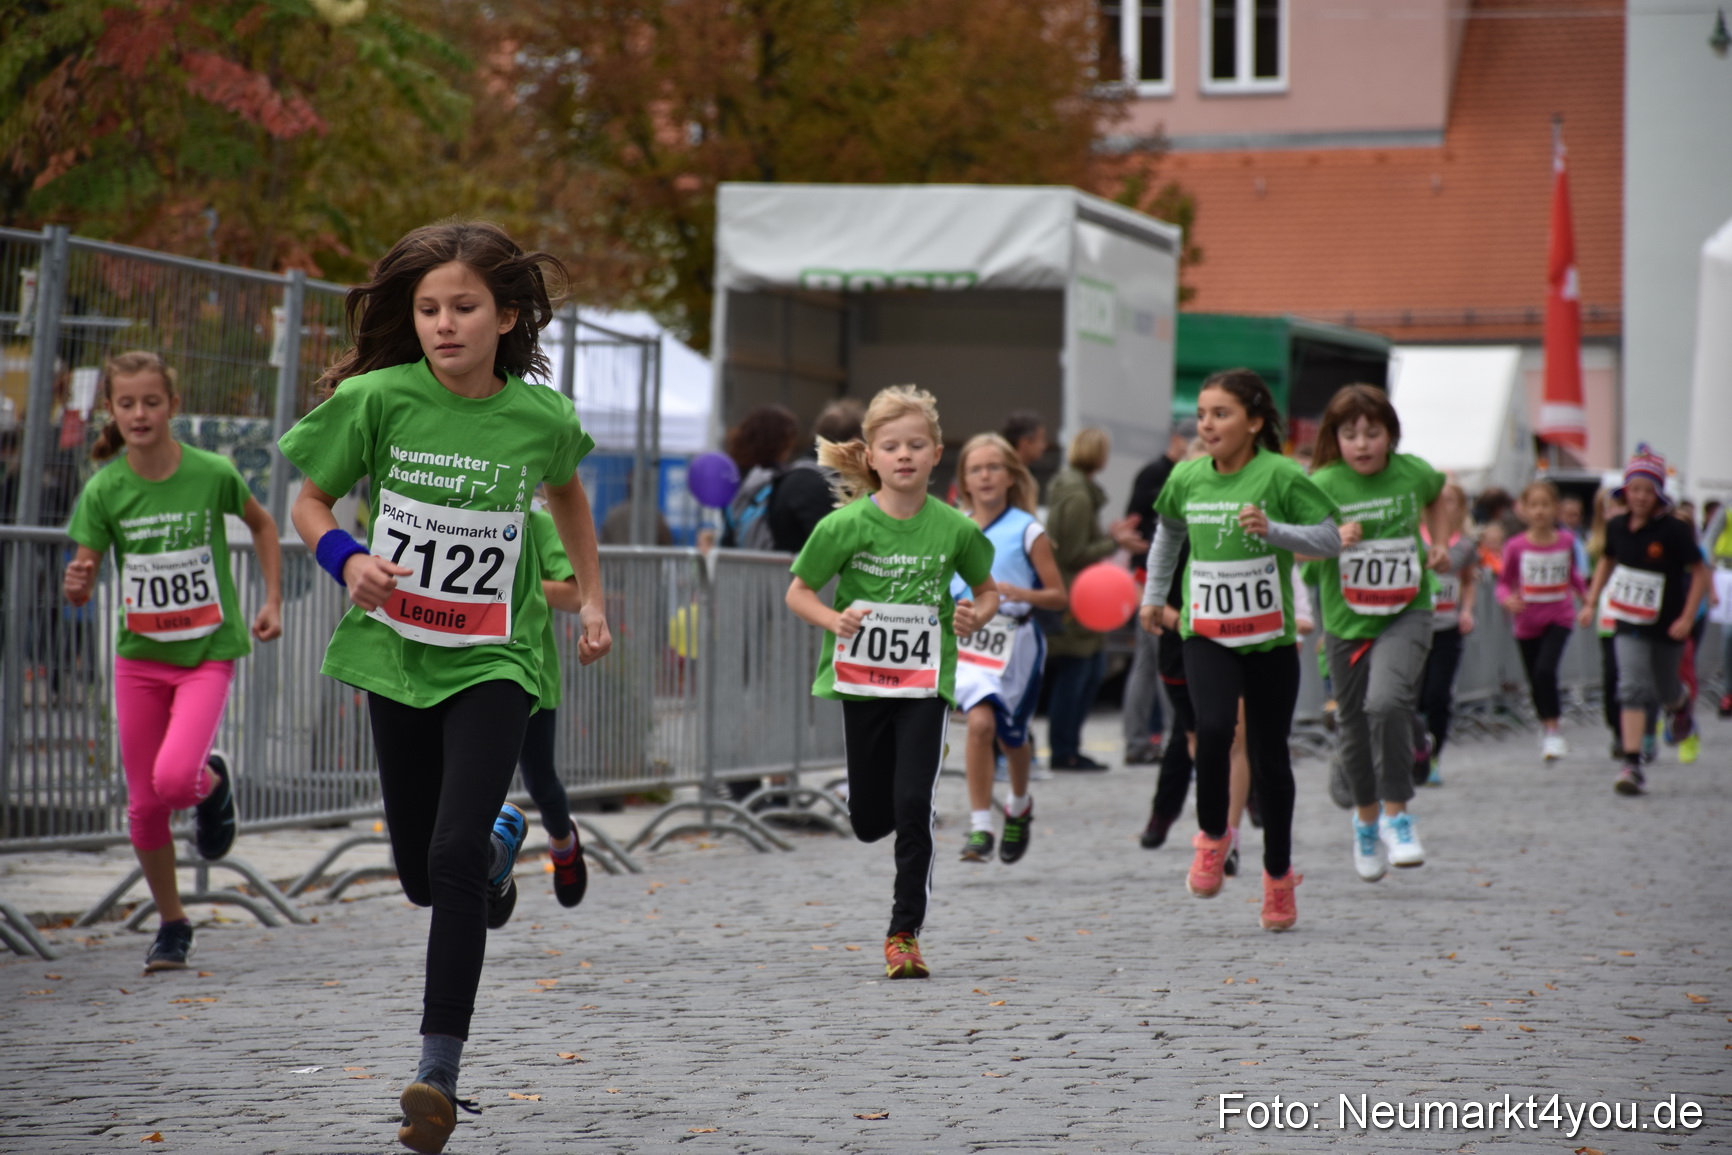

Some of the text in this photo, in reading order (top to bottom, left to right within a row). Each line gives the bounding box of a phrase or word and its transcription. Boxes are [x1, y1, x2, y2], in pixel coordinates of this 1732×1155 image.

[390, 445, 490, 472] Neumarkter
[388, 464, 467, 493] Stadtlauf
[383, 503, 422, 529] PARTL
[426, 518, 498, 539] Neumarkt
[387, 527, 505, 596] 7122
[851, 560, 905, 579] Stadtlauf
[1349, 558, 1412, 586] 7071
[131, 570, 210, 608] 7085
[1199, 579, 1274, 615] 7016
[155, 614, 192, 630] Lucia
[400, 598, 467, 629] Leonie
[875, 612, 925, 625] Neumarkt
[1218, 621, 1255, 636] Alicia
[850, 626, 931, 665] 7054
[868, 670, 900, 687] Lara
